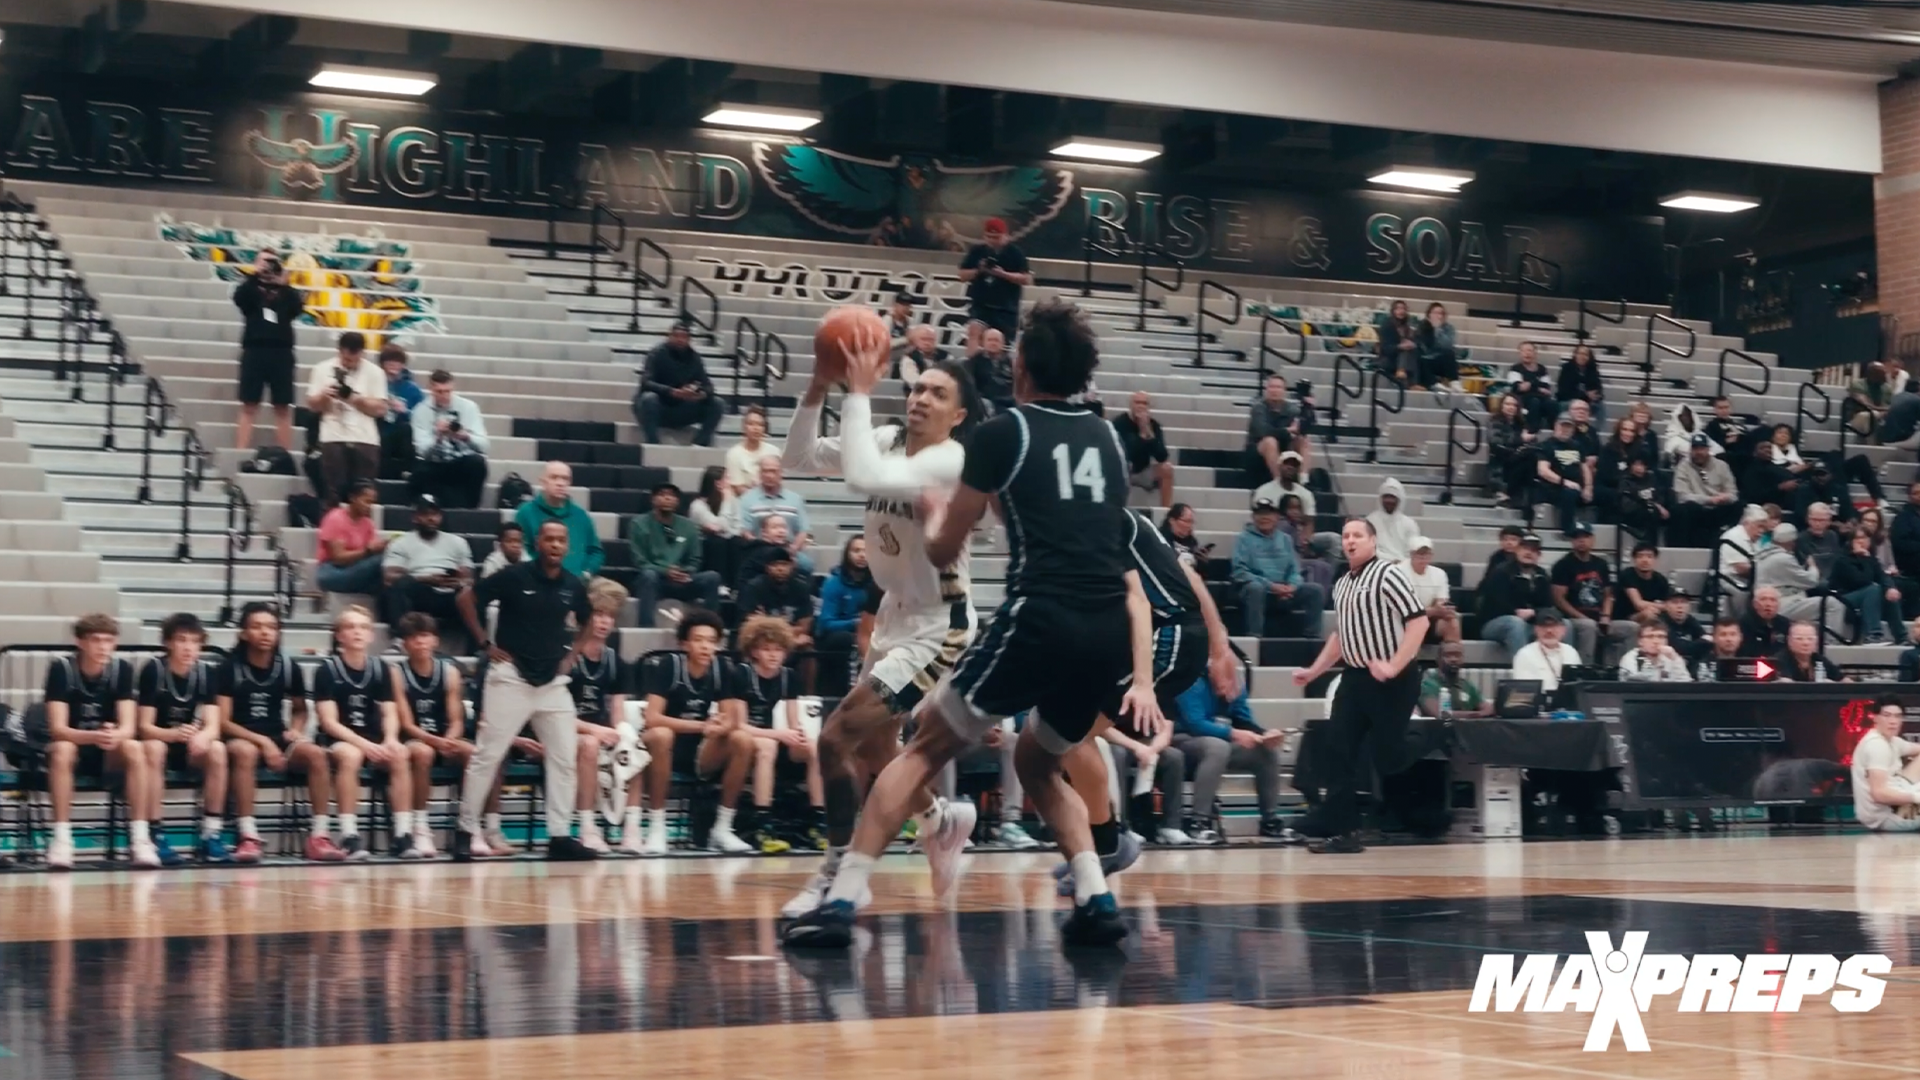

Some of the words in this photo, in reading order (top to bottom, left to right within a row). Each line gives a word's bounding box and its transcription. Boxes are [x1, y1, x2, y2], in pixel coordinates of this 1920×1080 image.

[5, 94, 216, 182] ARE
[1080, 187, 1252, 263] RISE
[1287, 216, 1331, 271] &
[1366, 213, 1552, 290] SOAR
[1052, 443, 1106, 504] 14
